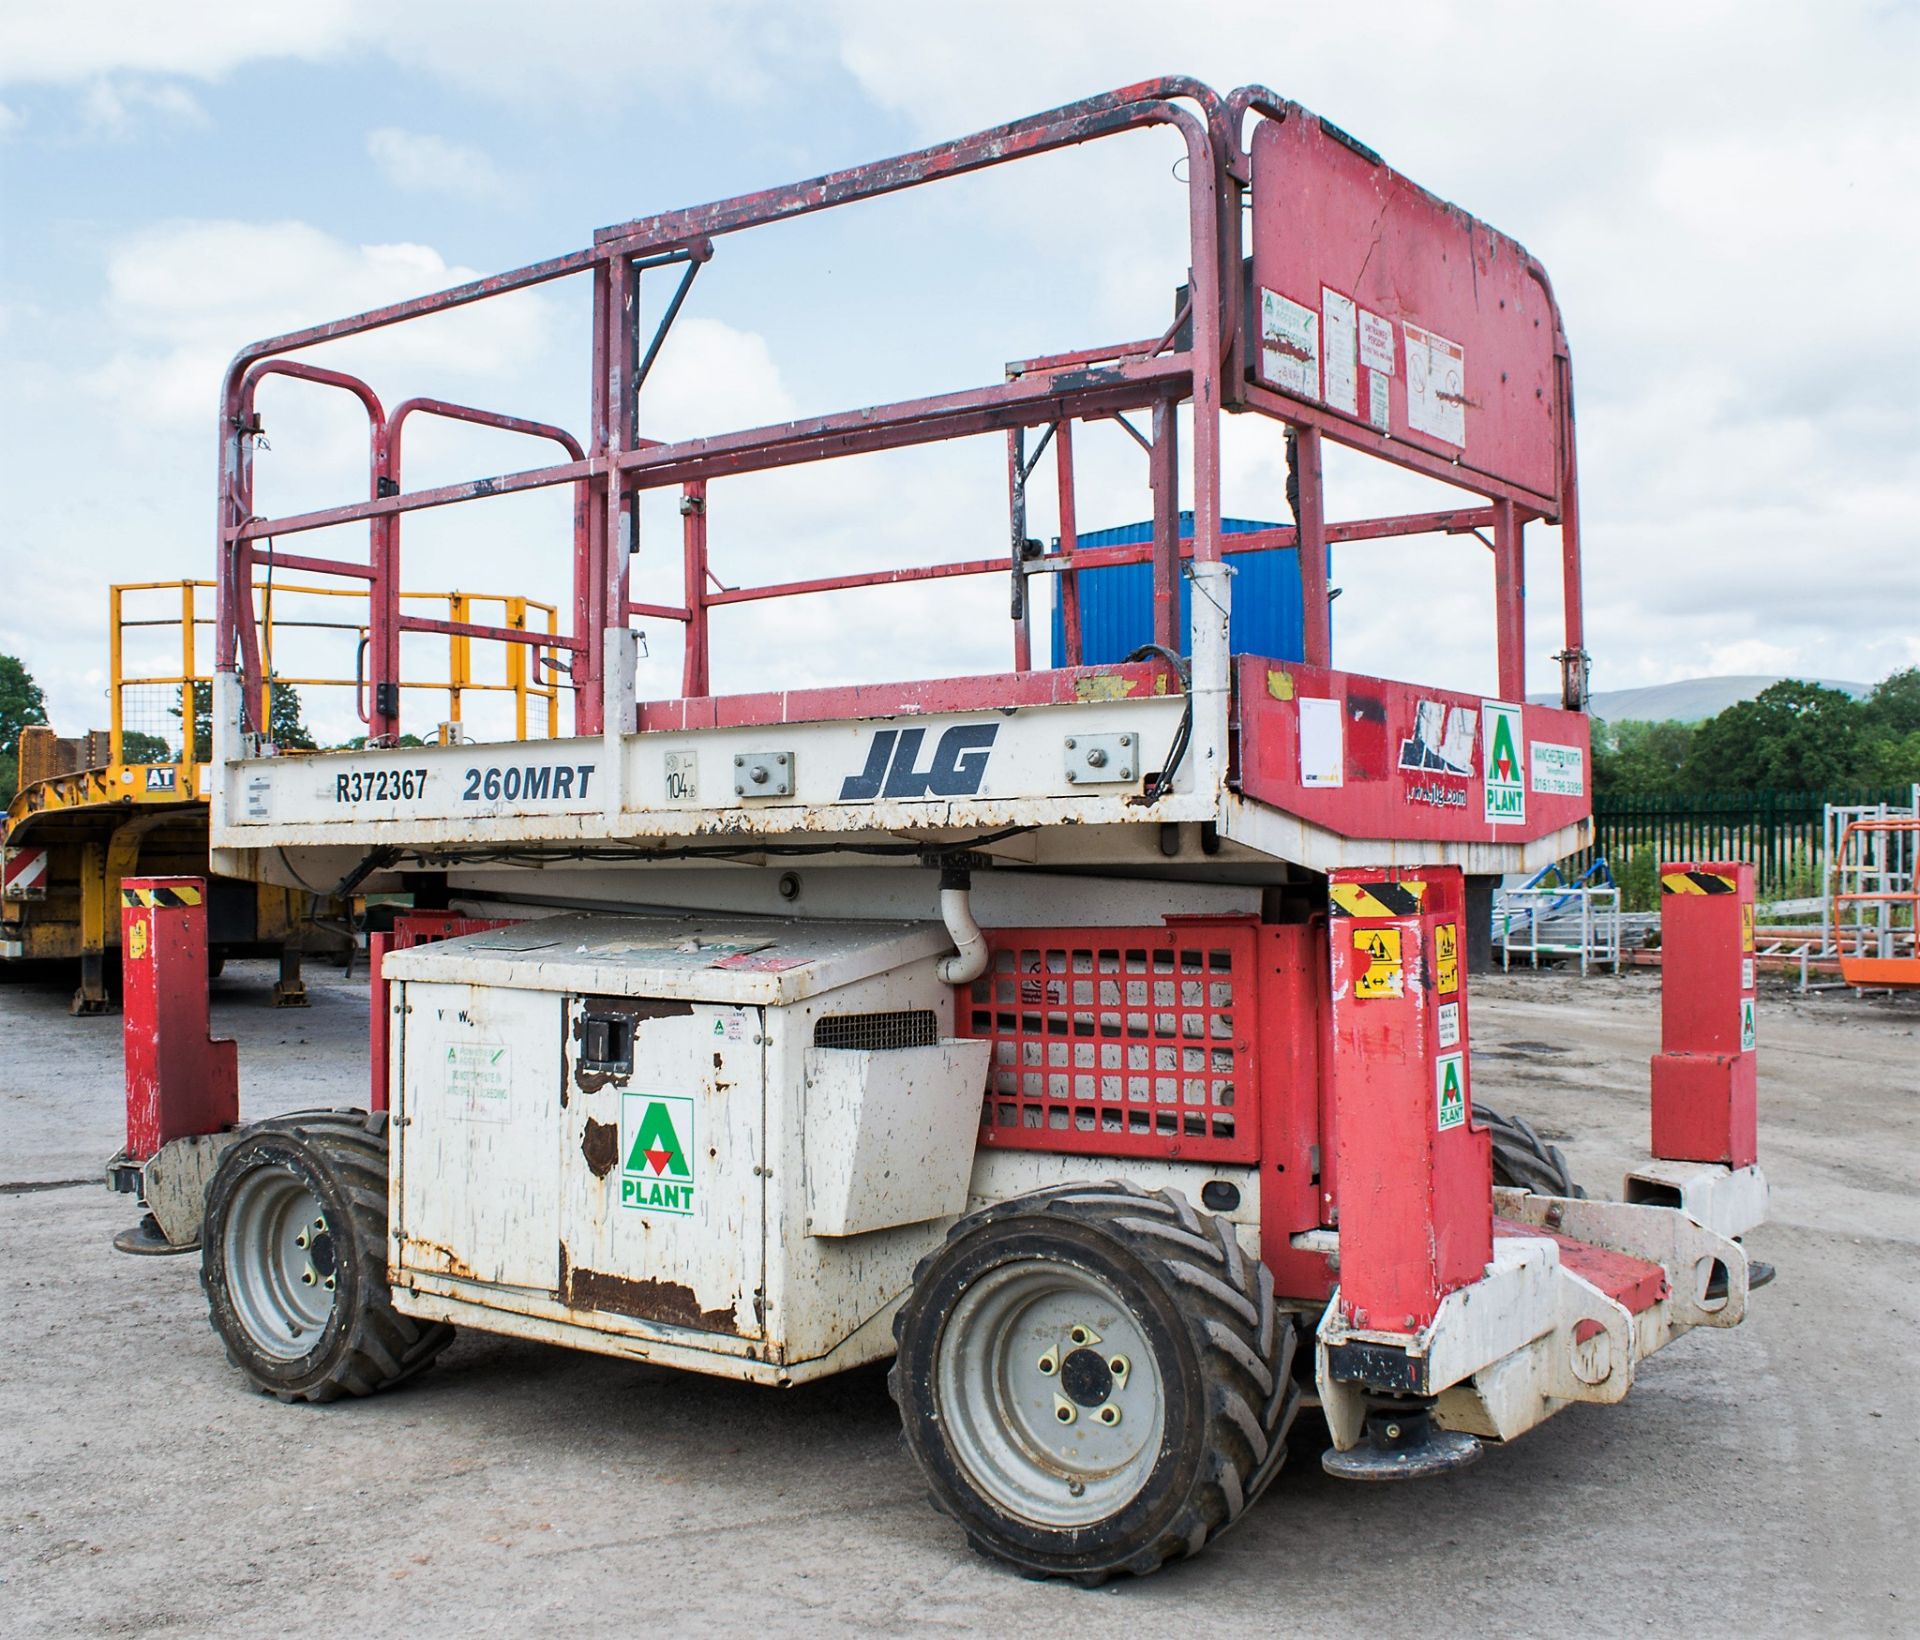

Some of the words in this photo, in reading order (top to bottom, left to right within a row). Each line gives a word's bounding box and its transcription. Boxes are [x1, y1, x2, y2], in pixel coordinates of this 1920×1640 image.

[839, 723, 1000, 800] JLG
[1488, 714, 1521, 781] A
[148, 768, 174, 786] AT
[337, 769, 428, 802] R372367
[463, 765, 595, 801] 260MRT
[666, 772, 688, 799] 104
[1487, 789, 1524, 811] PLANT
[1442, 1062, 1462, 1107] A
[1440, 1106, 1463, 1124] PLANT
[625, 1102, 690, 1177] A
[622, 1180, 694, 1210] PLANT
